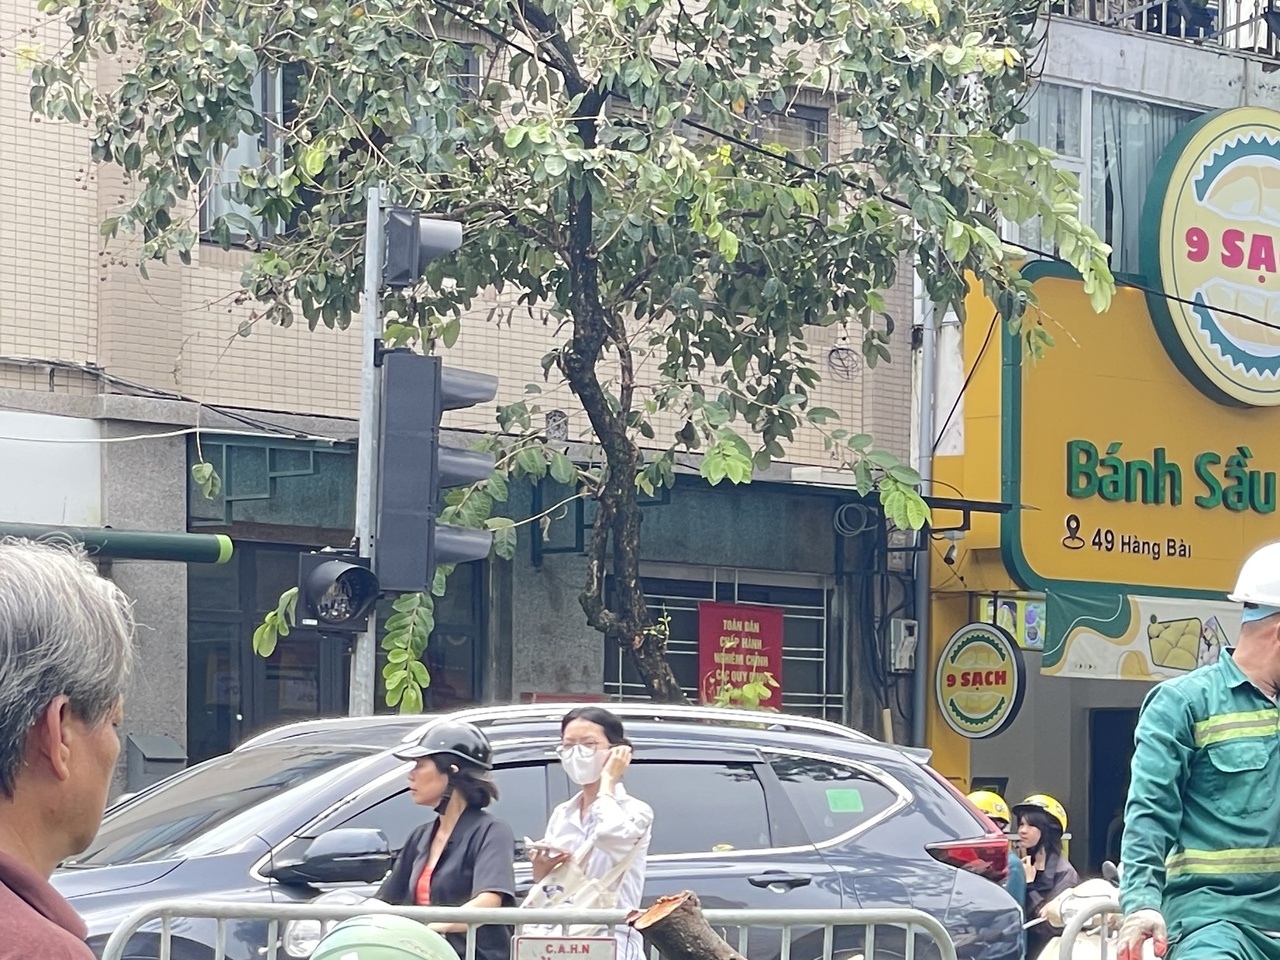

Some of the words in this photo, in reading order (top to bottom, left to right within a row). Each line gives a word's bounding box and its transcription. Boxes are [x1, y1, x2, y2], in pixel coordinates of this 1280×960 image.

[1185, 226, 1209, 263] 9
[1066, 439, 1183, 507] Bánh
[1194, 446, 1276, 514] Sầu
[1091, 528, 1115, 552] 49
[1121, 532, 1161, 560] Hàng
[1166, 537, 1192, 558] Bài
[946, 673, 956, 688] 9
[961, 670, 1007, 690] SẠCH
[545, 944, 590, 954] C.A.H.N
